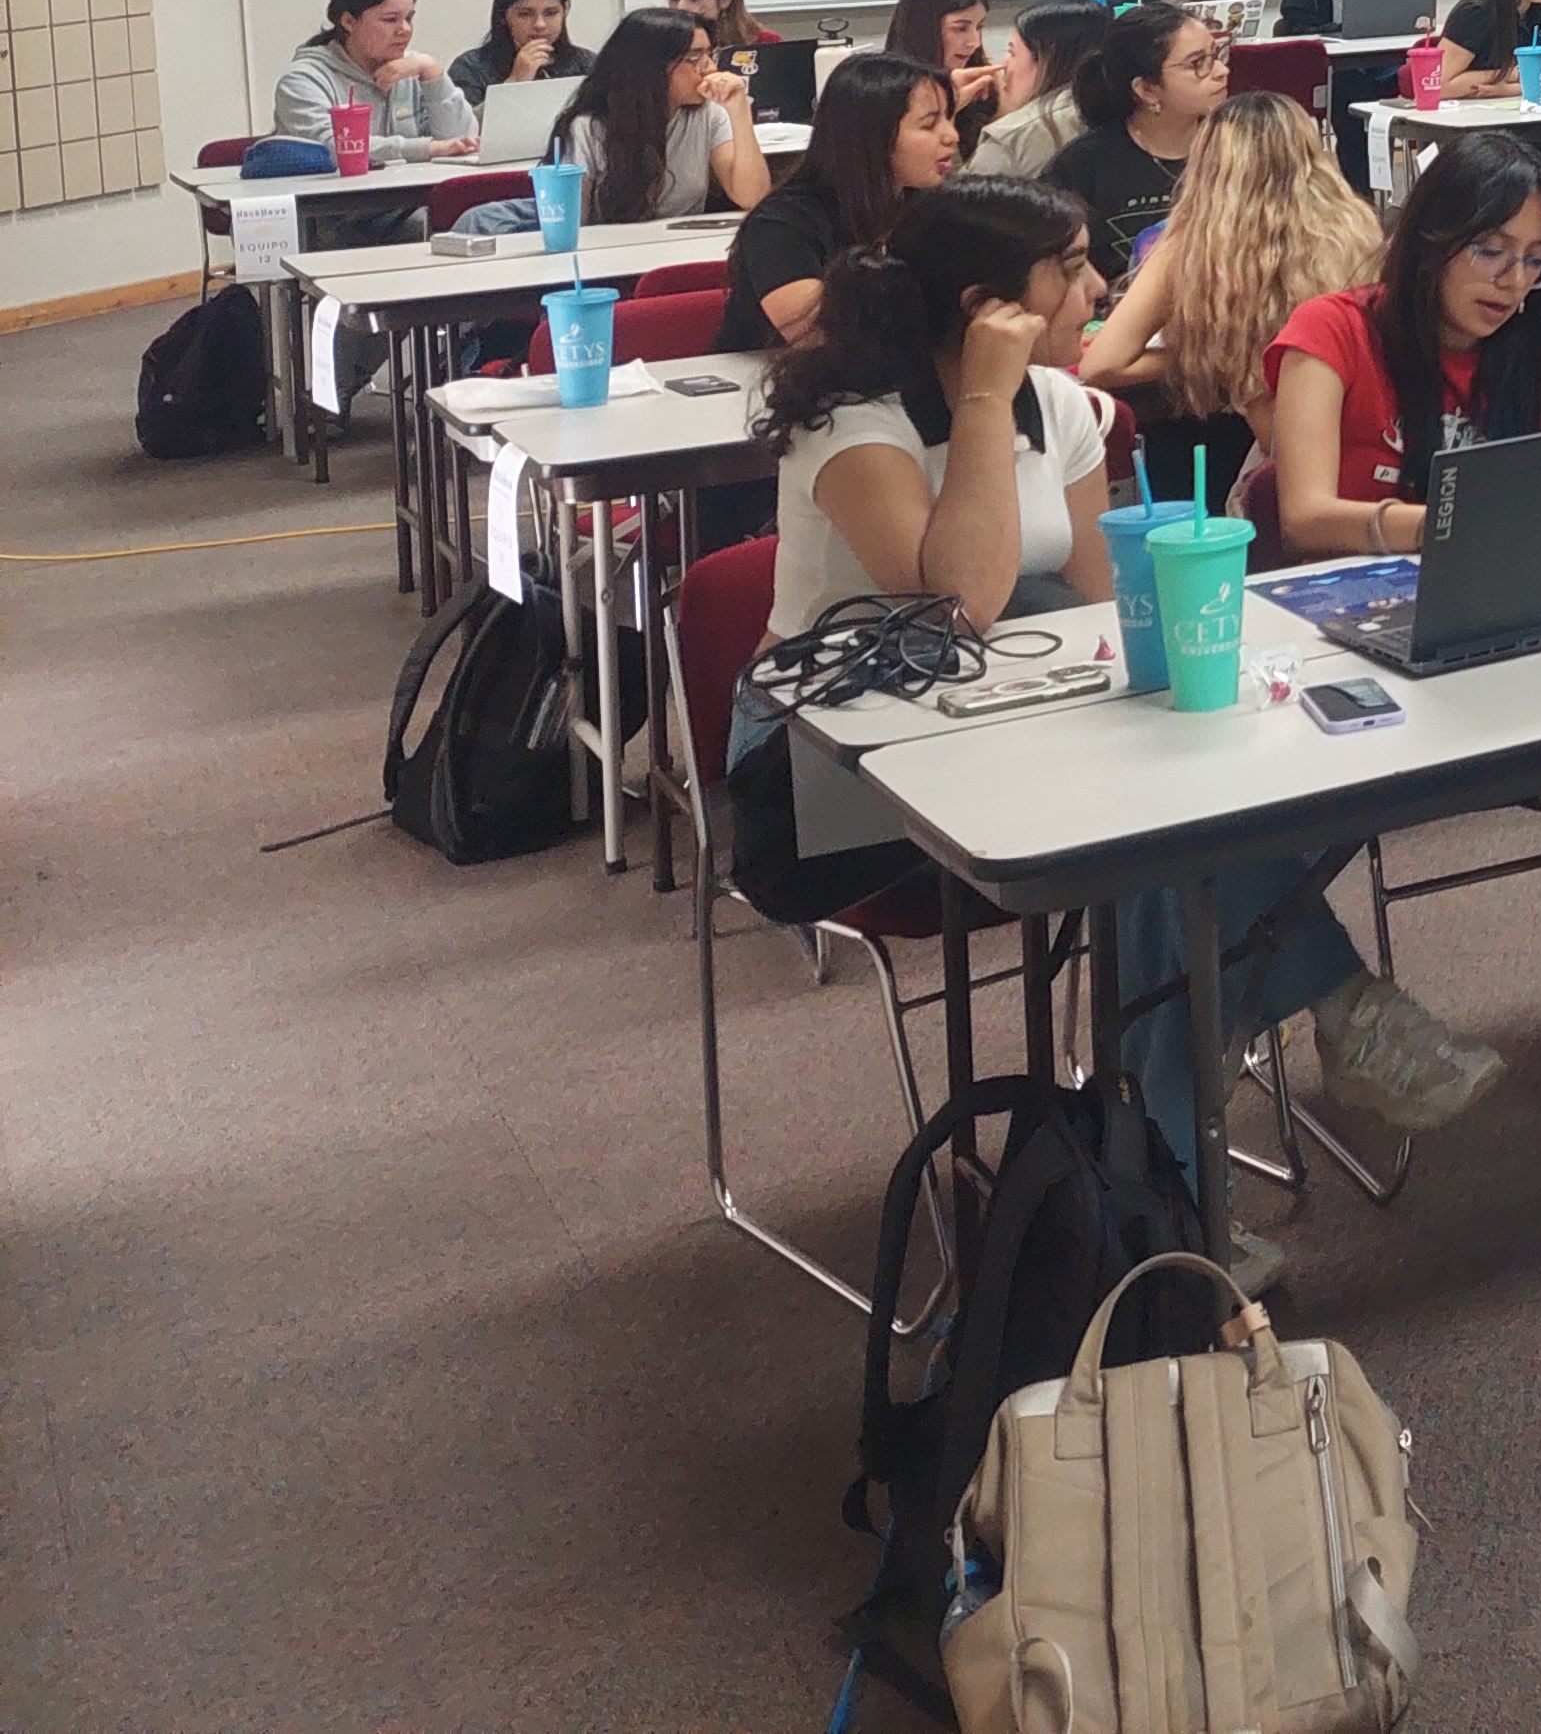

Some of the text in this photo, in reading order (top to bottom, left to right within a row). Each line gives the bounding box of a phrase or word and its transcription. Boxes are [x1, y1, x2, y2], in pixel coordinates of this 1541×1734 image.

[239, 240, 289, 253] EQUIPO
[258, 254, 271, 264] 13
[1435, 466, 1458, 541] LEGION
